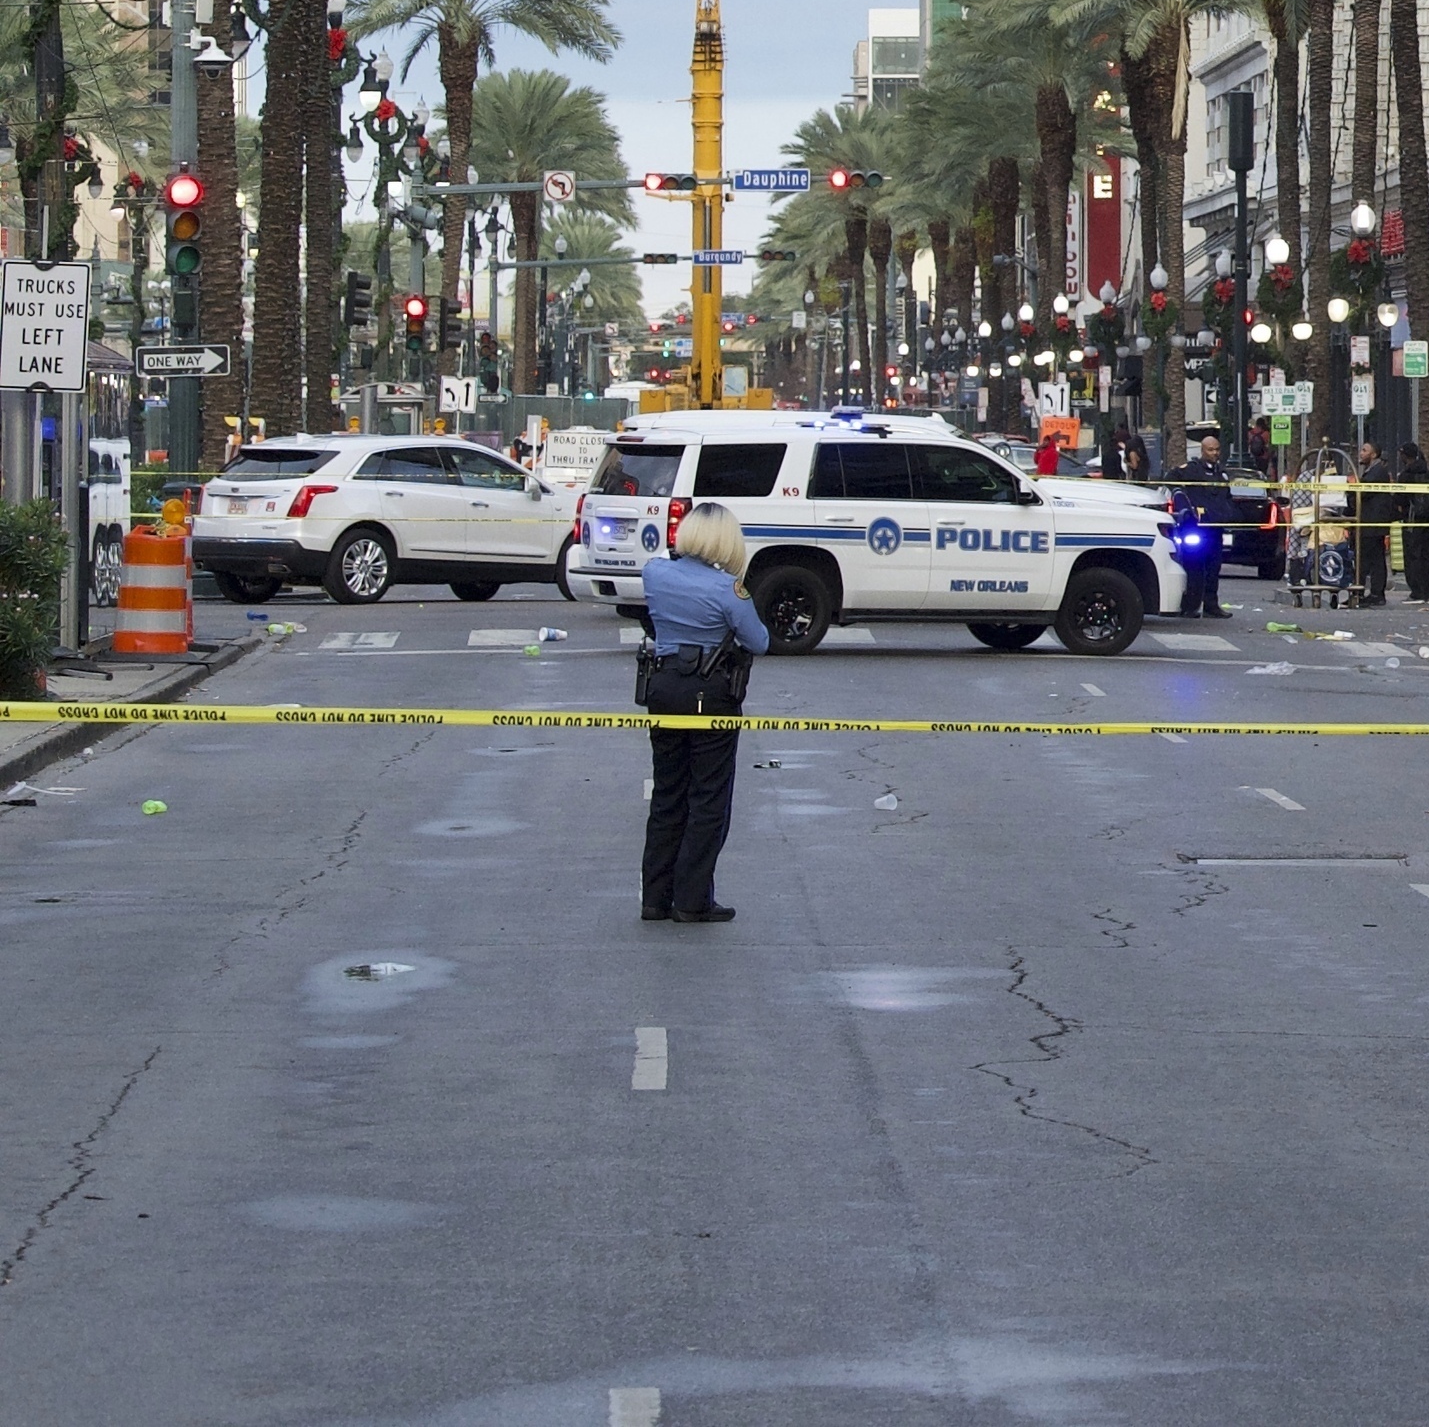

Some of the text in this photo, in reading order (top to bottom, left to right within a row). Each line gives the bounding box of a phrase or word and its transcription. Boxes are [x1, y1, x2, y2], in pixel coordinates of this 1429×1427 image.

[743, 171, 808, 189] Dauphine
[699, 252, 742, 264] Burgundy
[17, 279, 76, 295] TRUCKS
[5, 302, 84, 319] MUST USE
[22, 328, 64, 345] LEFT
[19, 356, 63, 373] LANE
[147, 355, 202, 368] ONE WAY
[1044, 420, 1076, 430] DETOUR
[554, 436, 576, 445] ROAD
[552, 457, 575, 465] THRU
[783, 487, 799, 497] K9
[647, 505, 660, 515] K9
[936, 527, 1049, 554] POLICE
[950, 580, 1029, 593] NEW ORLEANS
[58, 706, 227, 721] POLICE LINE DO NOT CROSS
